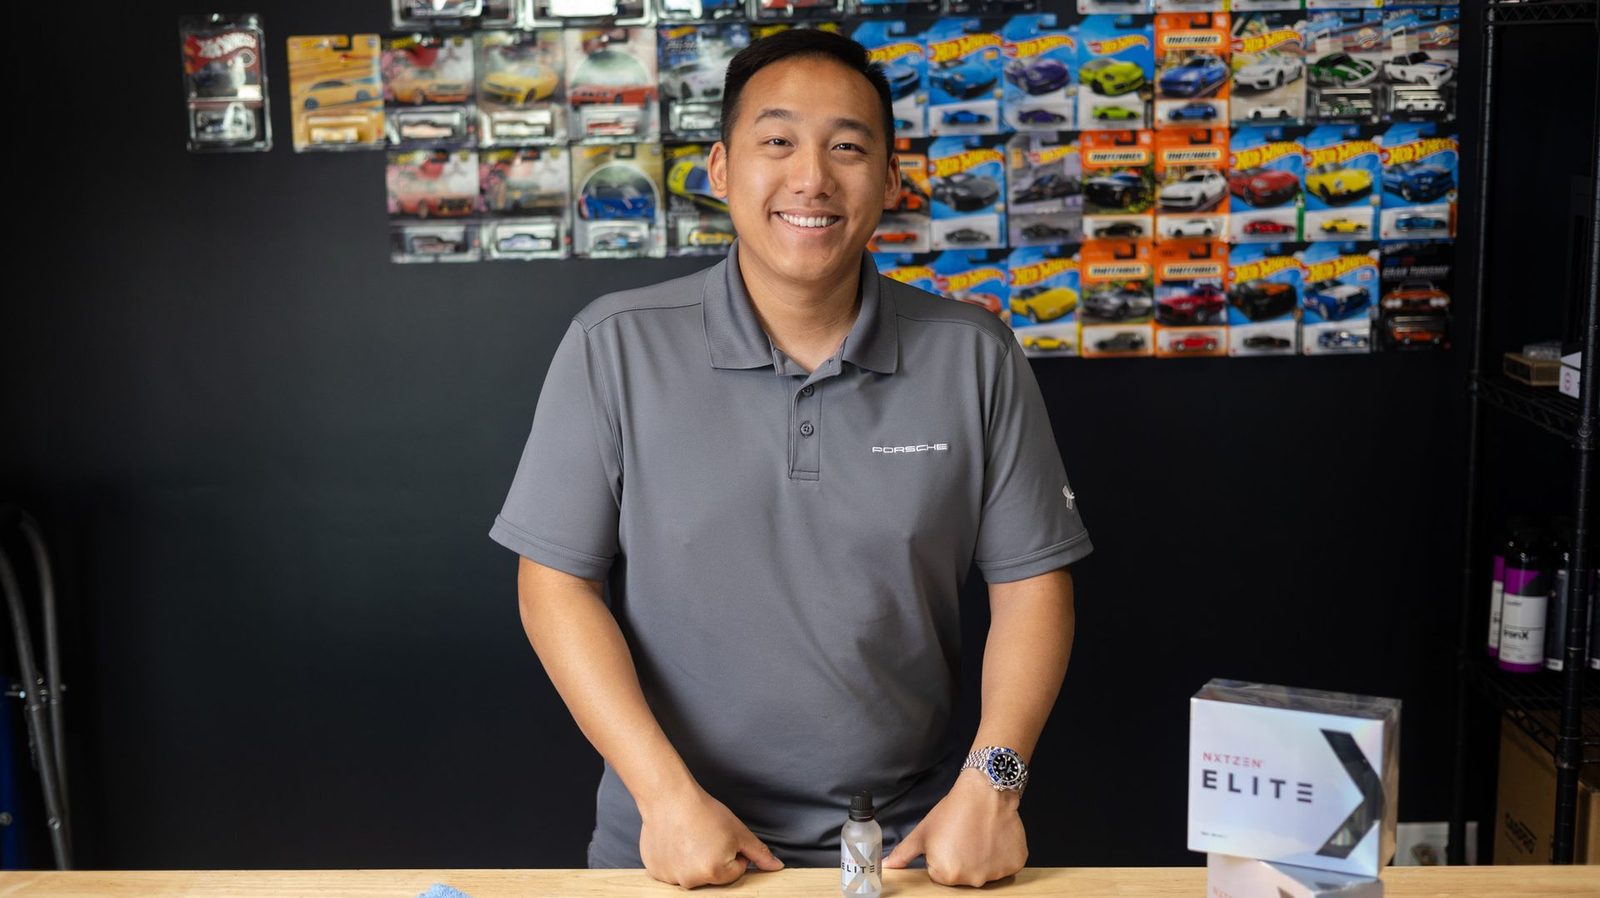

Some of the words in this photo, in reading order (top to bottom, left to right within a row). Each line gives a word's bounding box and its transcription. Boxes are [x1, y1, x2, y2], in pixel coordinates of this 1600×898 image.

[872, 443, 948, 454] PORSCHE
[1201, 769, 1314, 804] ELITE
[841, 862, 875, 874] ELITE
